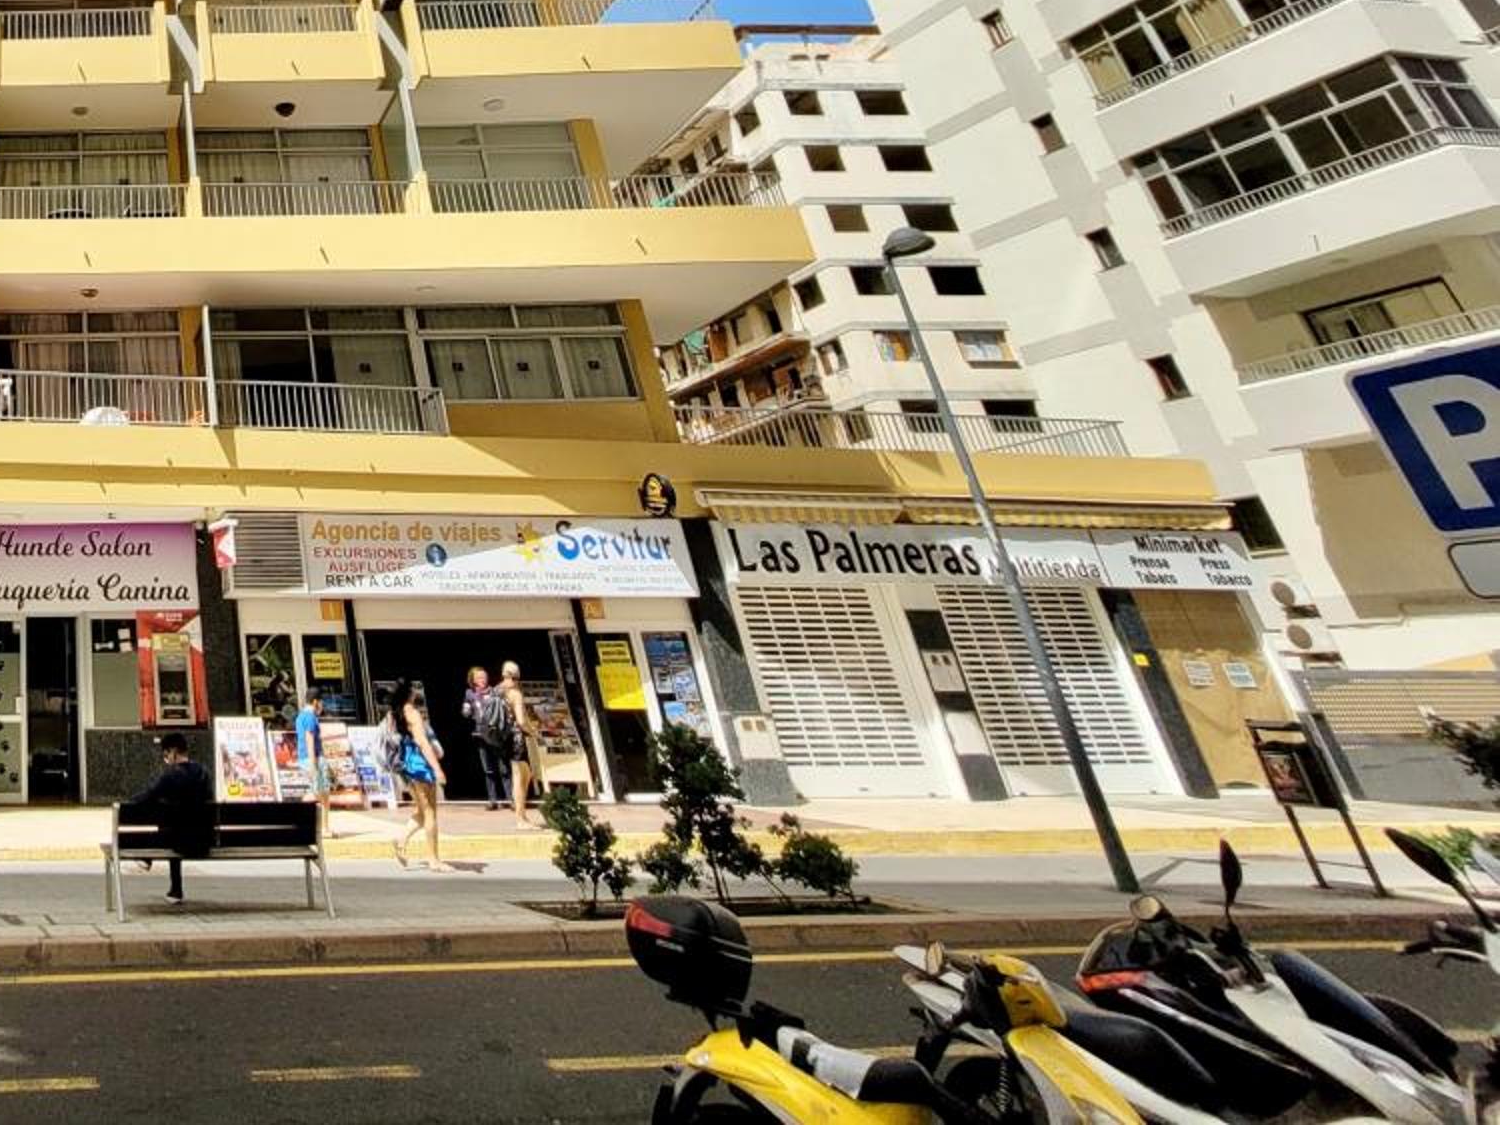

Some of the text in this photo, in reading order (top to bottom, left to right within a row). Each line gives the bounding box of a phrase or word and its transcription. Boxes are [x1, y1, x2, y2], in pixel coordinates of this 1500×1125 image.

[1388, 375, 1500, 510] P
[80, 531, 153, 558] Salon
[311, 520, 501, 546] Agencia de viajes
[556, 521, 670, 560] Servitur
[1133, 534, 1223, 554] Minimarket
[313, 546, 418, 560] EXCURSIONES
[728, 528, 981, 575] Las Palmeras
[1199, 556, 1231, 570] Press
[97, 573, 190, 602] Canina
[325, 575, 414, 588] RENT A CAR
[1135, 571, 1178, 585] Tabaco
